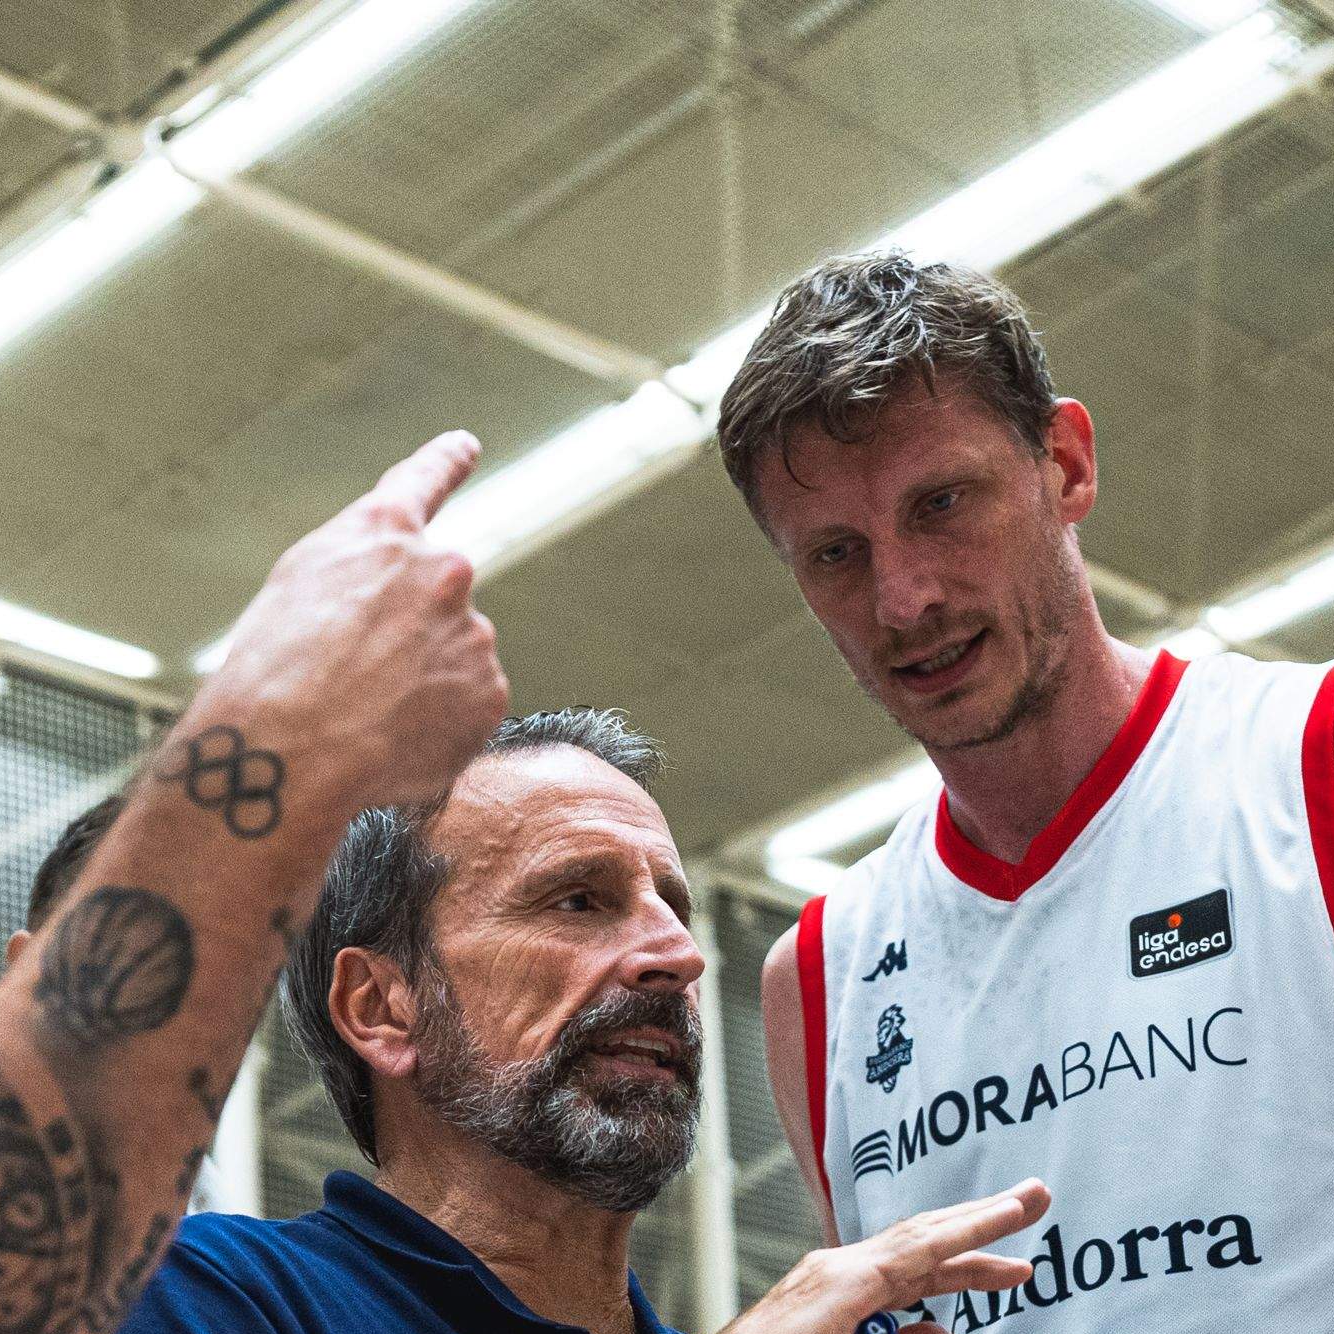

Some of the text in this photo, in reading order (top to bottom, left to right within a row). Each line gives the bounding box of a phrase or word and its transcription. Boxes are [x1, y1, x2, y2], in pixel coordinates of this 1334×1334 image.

[1138, 929, 1179, 952] liga
[1139, 931, 1226, 969] endesa
[895, 1006, 1248, 1174] MORABANC
